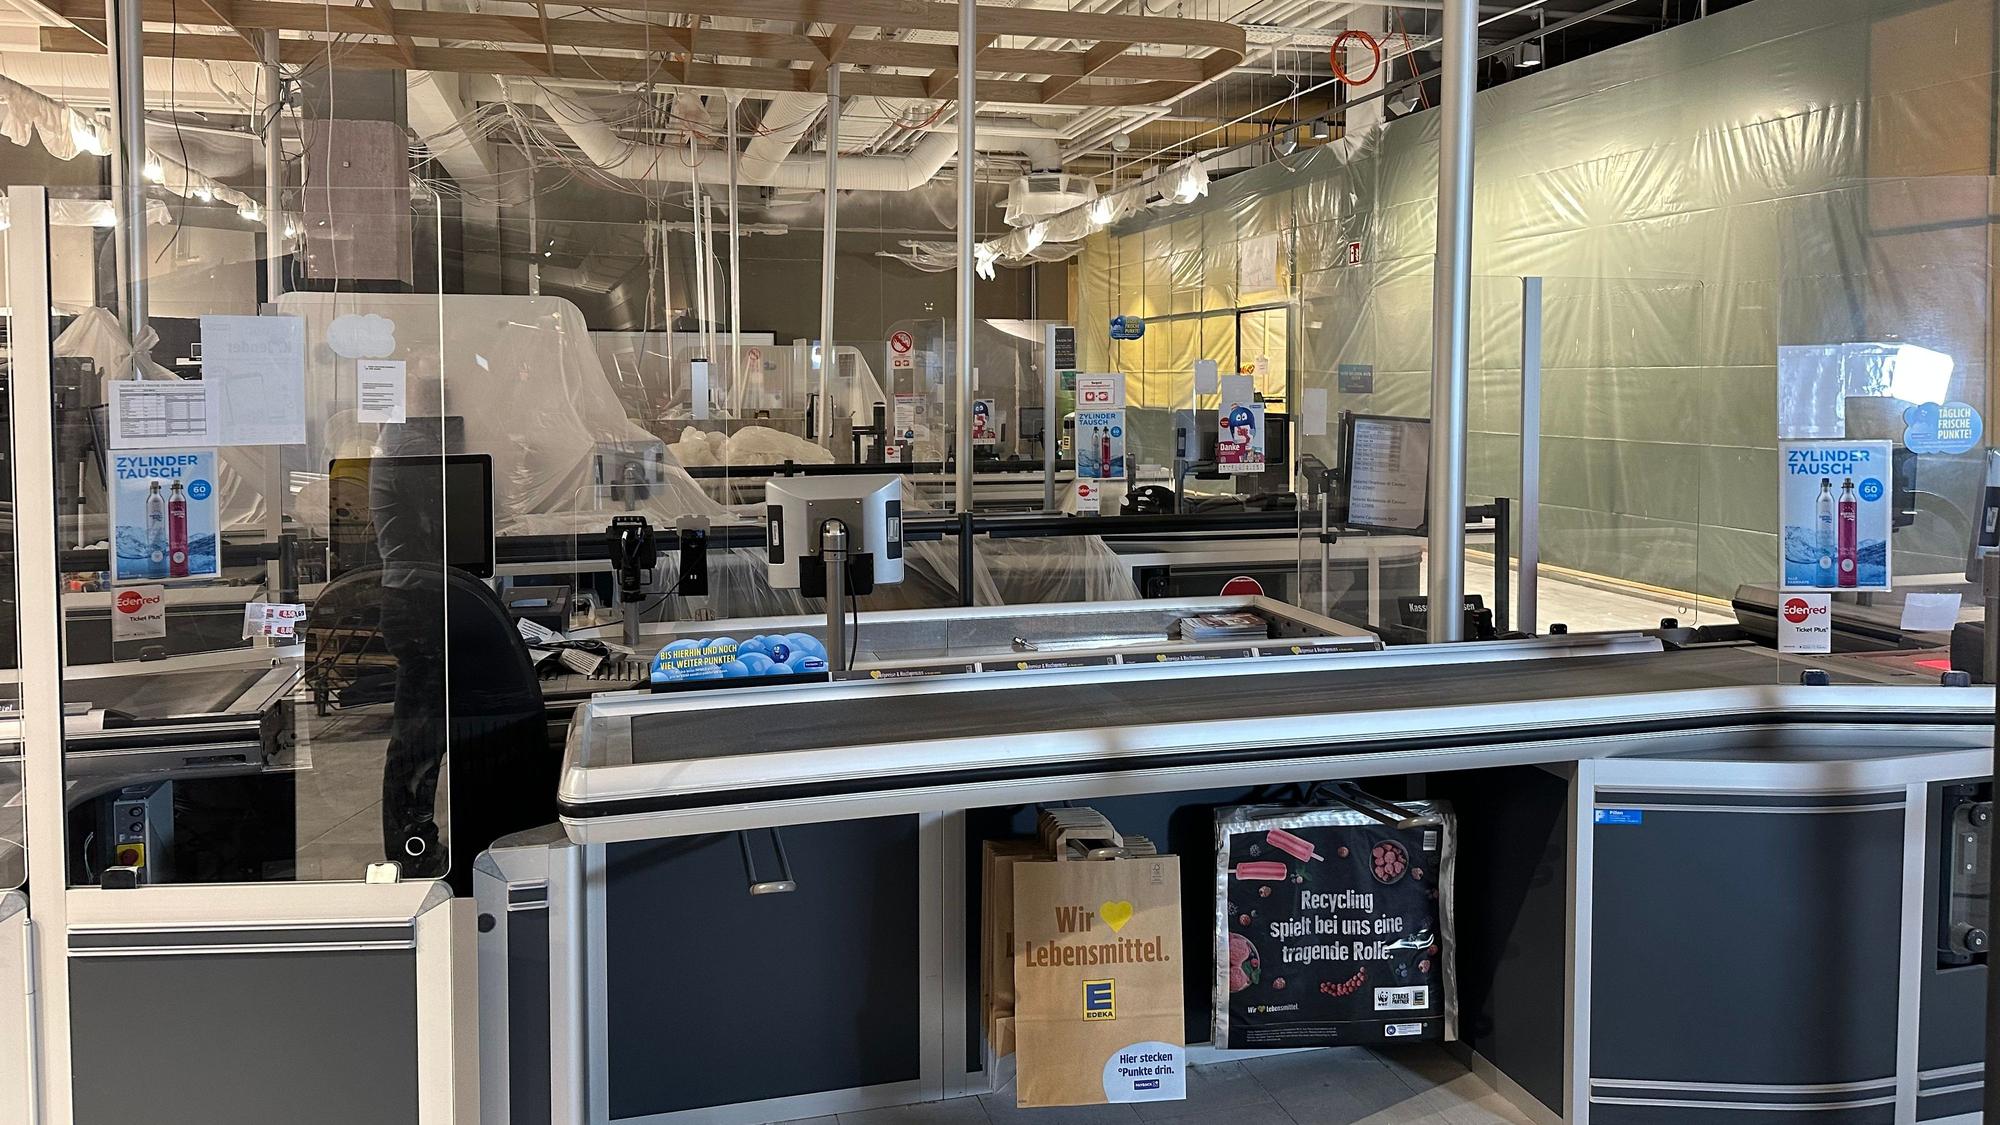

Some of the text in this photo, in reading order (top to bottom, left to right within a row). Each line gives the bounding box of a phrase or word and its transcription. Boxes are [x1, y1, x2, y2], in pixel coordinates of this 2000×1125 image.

[1939, 408, 1971, 418] TÄGLICH
[1938, 419, 1971, 429] FRISCHE
[1937, 429, 1972, 440] PUNKTE!
[1220, 443, 1241, 451] Danke
[116, 455, 199, 468] ZYLINDER
[1788, 450, 1870, 462] ZYLINDER
[116, 467, 182, 479] TAUSCH
[1788, 463, 1853, 475] TAUSCH
[1864, 485, 1878, 494] 60
[116, 595, 160, 607] Edenred
[1783, 605, 1827, 615] Edenred
[660, 644, 737, 660] BIS HIERHIN UND NOCH
[660, 654, 736, 671] VIEL WEITER PUNKTEN
[1301, 890, 1374, 914] Recycling
[1055, 906, 1095, 933] Wir
[1270, 913, 1403, 942] spielt bei uns eine
[1025, 935, 1171, 968] Lebensmittel.
[1282, 941, 1394, 965] tragende Rolle.
[1247, 1005, 1257, 1014] Wir
[1120, 1051, 1173, 1064] Hier stecken
[1154, 1064, 1175, 1075] drin.
